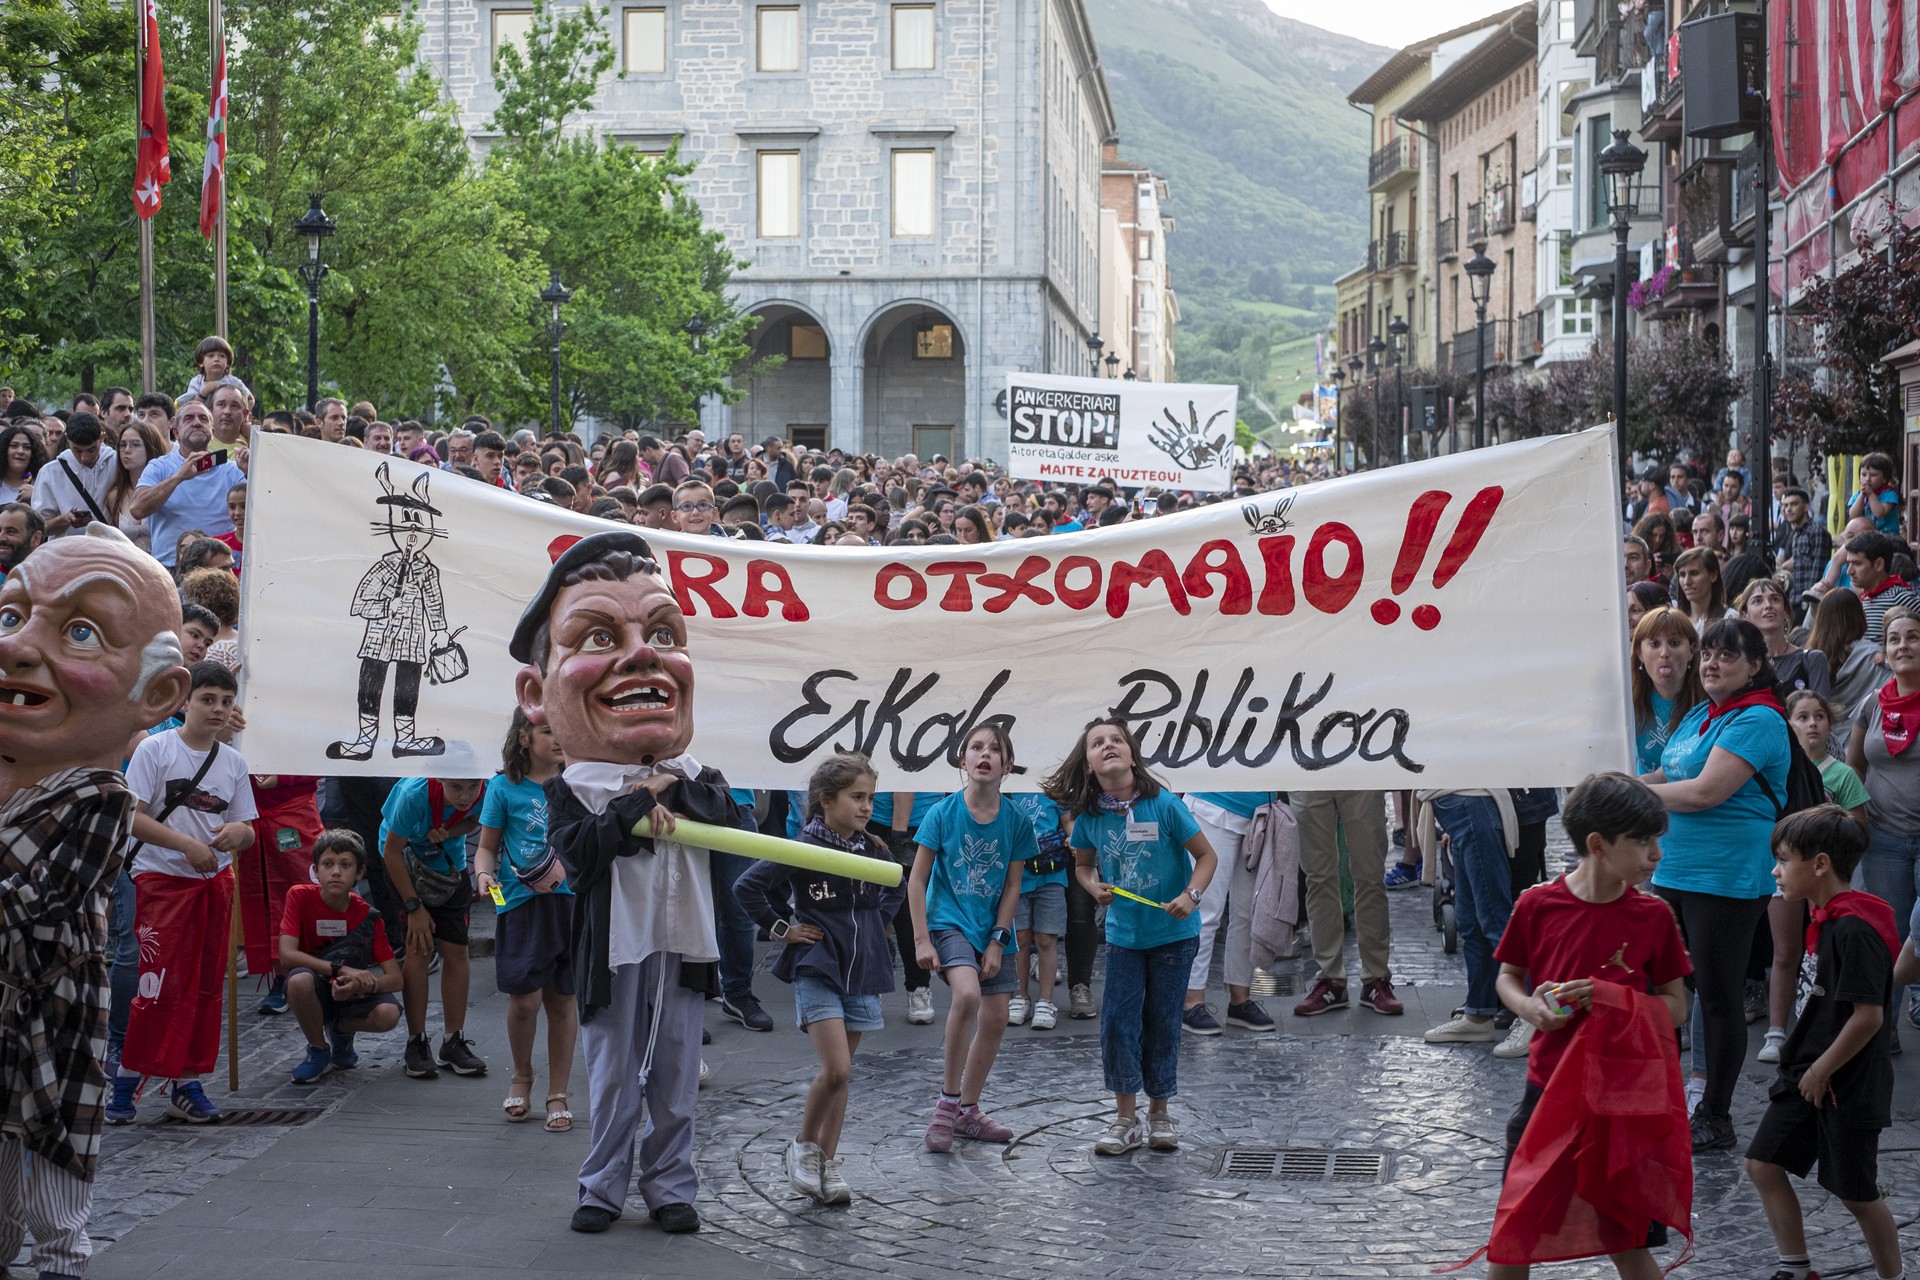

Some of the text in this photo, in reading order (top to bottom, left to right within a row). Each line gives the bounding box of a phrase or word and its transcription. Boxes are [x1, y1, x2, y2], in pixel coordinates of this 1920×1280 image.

[1014, 389, 1117, 412] ANKERKERIARI
[1014, 407, 1116, 445] STOP!
[1058, 448, 1092, 461] Galder
[1094, 453, 1120, 463] aske
[1040, 463, 1182, 484] MAITE ZAITUZTEGU!
